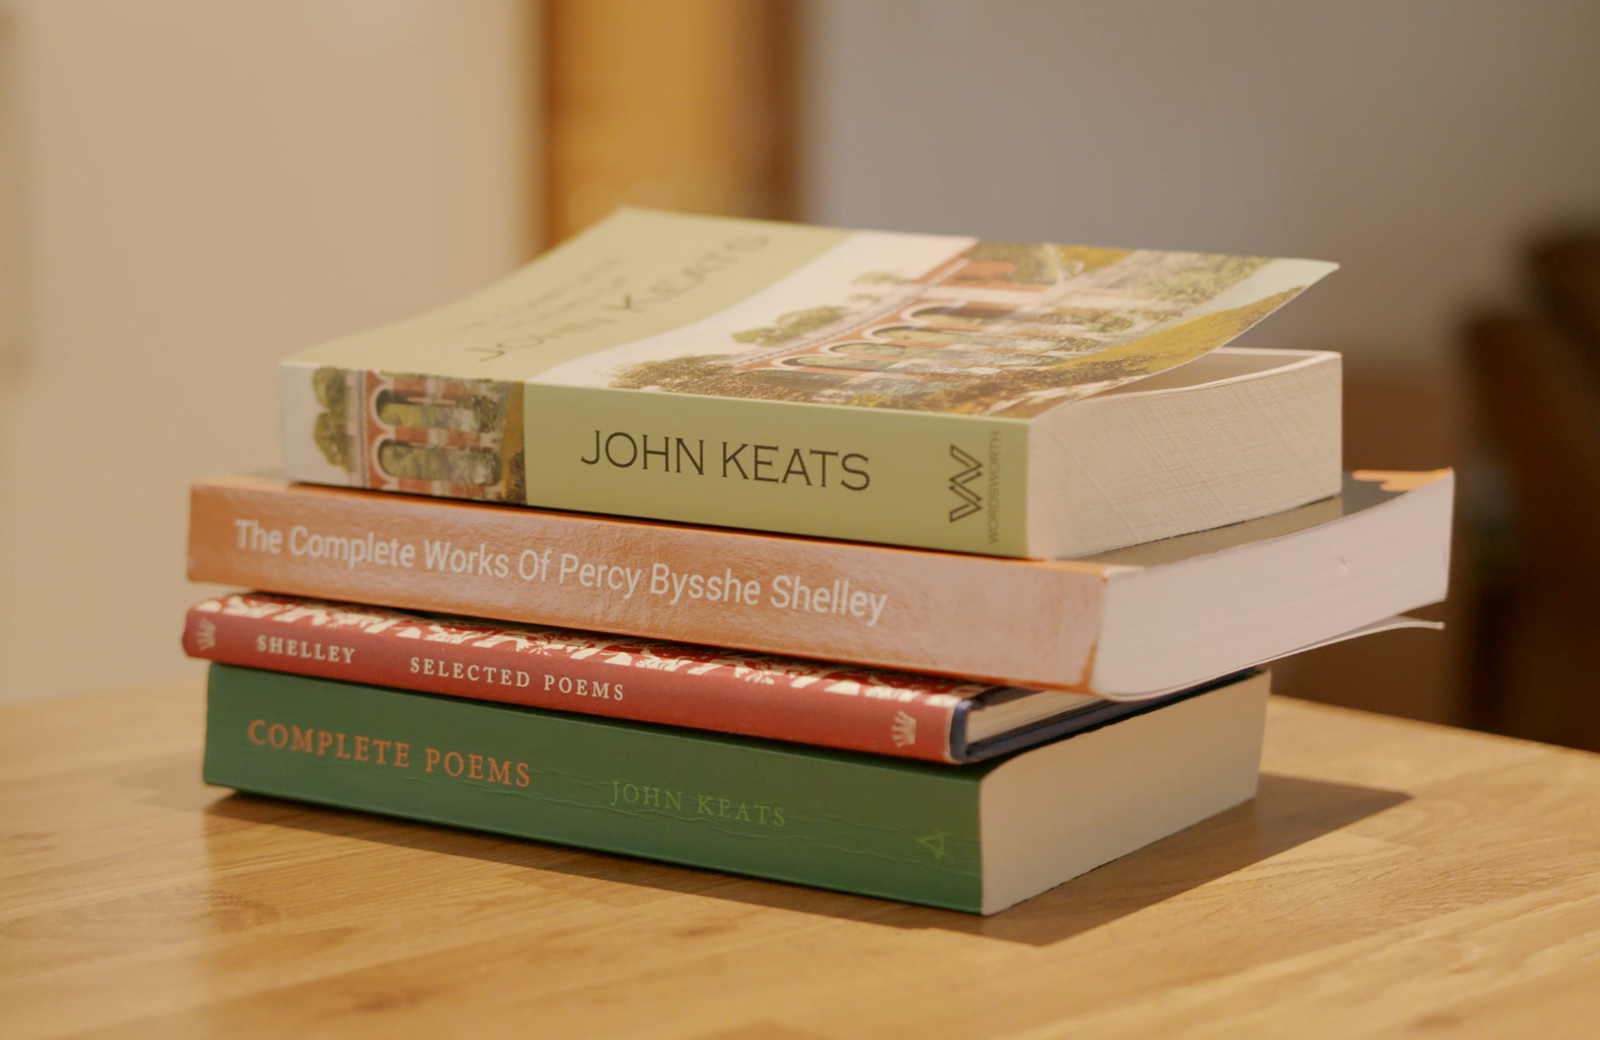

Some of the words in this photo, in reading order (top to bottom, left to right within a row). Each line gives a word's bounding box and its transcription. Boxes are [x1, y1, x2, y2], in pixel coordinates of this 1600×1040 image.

[580, 430, 705, 475] JOHN
[721, 441, 870, 491] KEATS
[988, 430, 1001, 544] WORDSWORTH
[235, 518, 283, 553] The
[288, 525, 416, 570] Complete
[423, 539, 509, 578] Works
[518, 549, 553, 582] Of
[558, 553, 642, 599] Percy
[650, 562, 761, 605] Bysshe
[770, 575, 887, 627] Shelley
[256, 635, 356, 664] SHELLEY
[409, 656, 530, 688] SELECTED
[543, 675, 624, 701] POEMS
[247, 719, 410, 768] COMPLETE
[424, 748, 531, 788] POEMS
[611, 780, 682, 811] JOHN
[697, 794, 786, 828] KEATS
